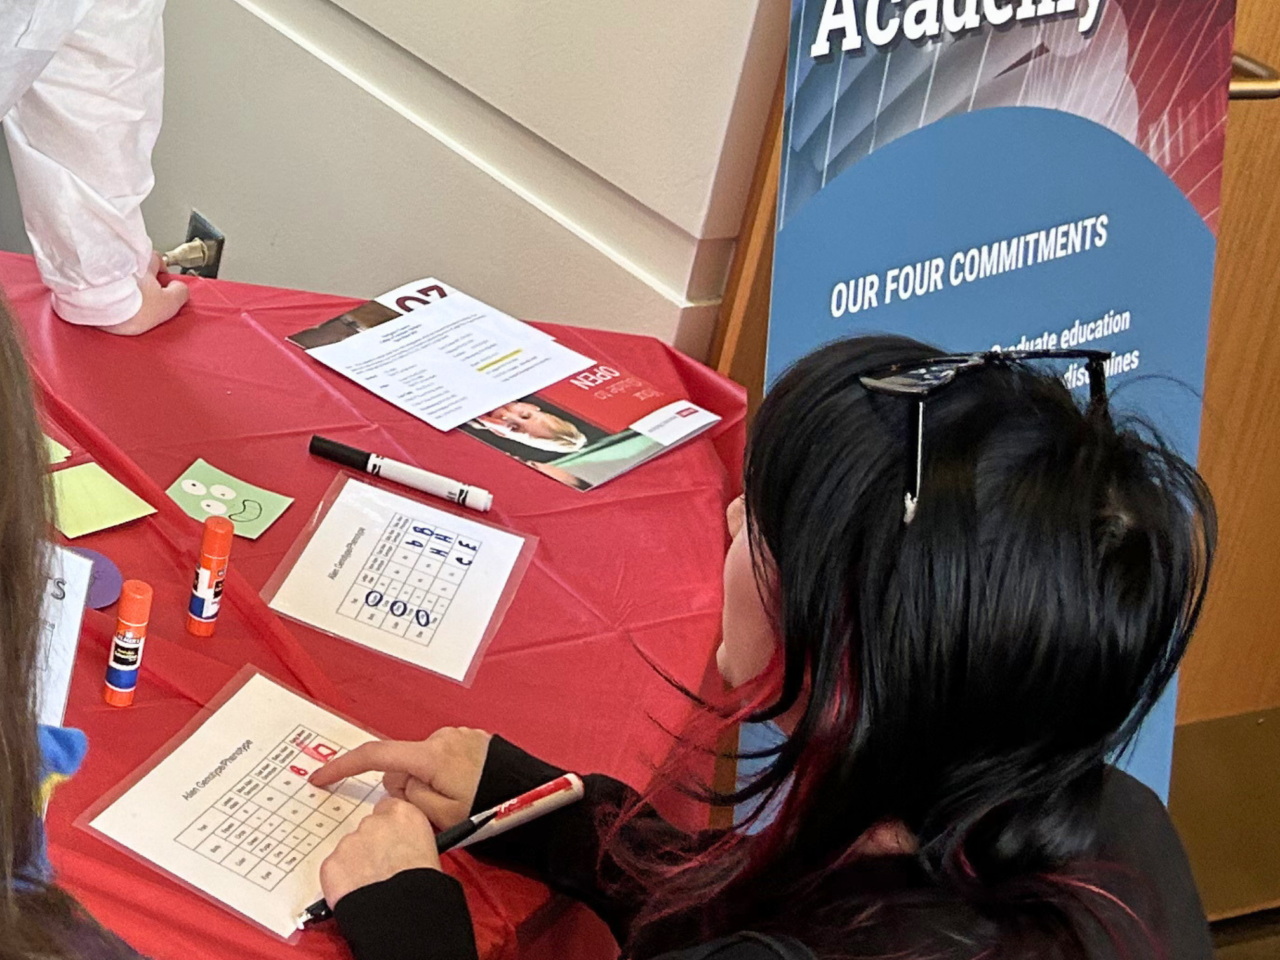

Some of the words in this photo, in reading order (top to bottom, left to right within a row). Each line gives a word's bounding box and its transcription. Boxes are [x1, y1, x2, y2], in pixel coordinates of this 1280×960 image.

[830, 274, 878, 318] OUR
[884, 258, 945, 306] FOUR
[949, 214, 1109, 287] COMMITMENTS
[1060, 309, 1131, 349] education
[569, 366, 620, 390] OPEN
